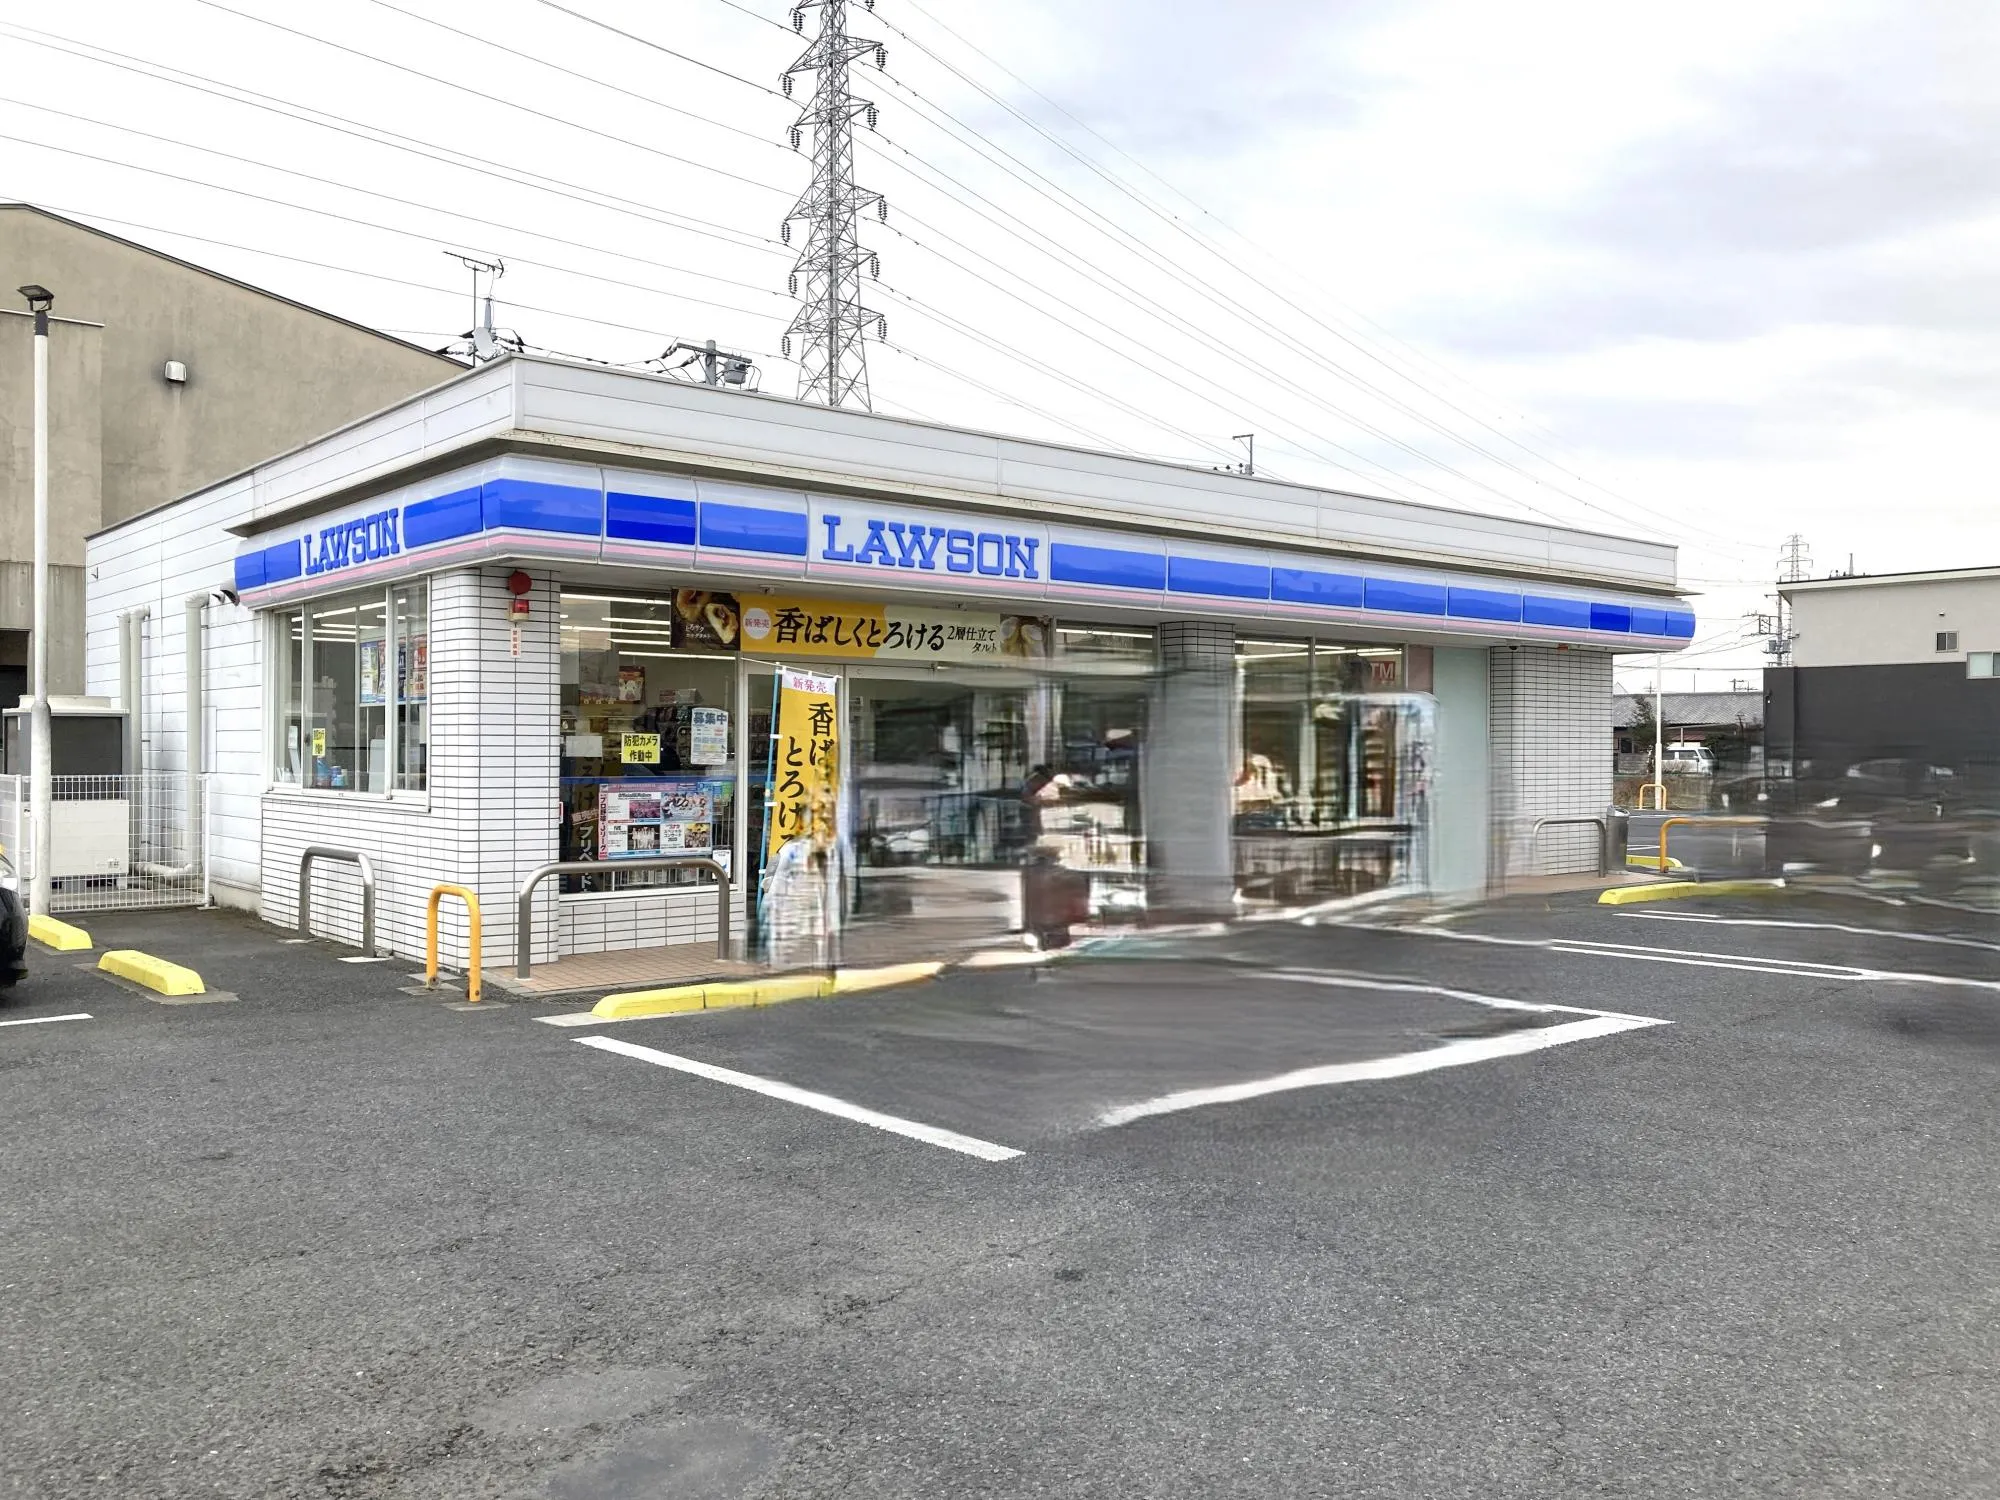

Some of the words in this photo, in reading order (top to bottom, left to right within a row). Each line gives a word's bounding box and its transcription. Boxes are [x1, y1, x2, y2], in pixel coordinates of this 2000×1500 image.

[304, 508, 400, 576] LAWSON
[823, 514, 1039, 579] LAWSON
[745, 618, 770, 629] 新発売
[773, 607, 945, 651] 香ばしくとろける
[947, 625, 997, 642] 2層仕立て
[971, 642, 997, 653] タルト
[793, 676, 827, 693] 新発売
[693, 711, 727, 725] 募集中
[624, 734, 659, 747] 防犯カメラ
[629, 750, 652, 762] 作動中
